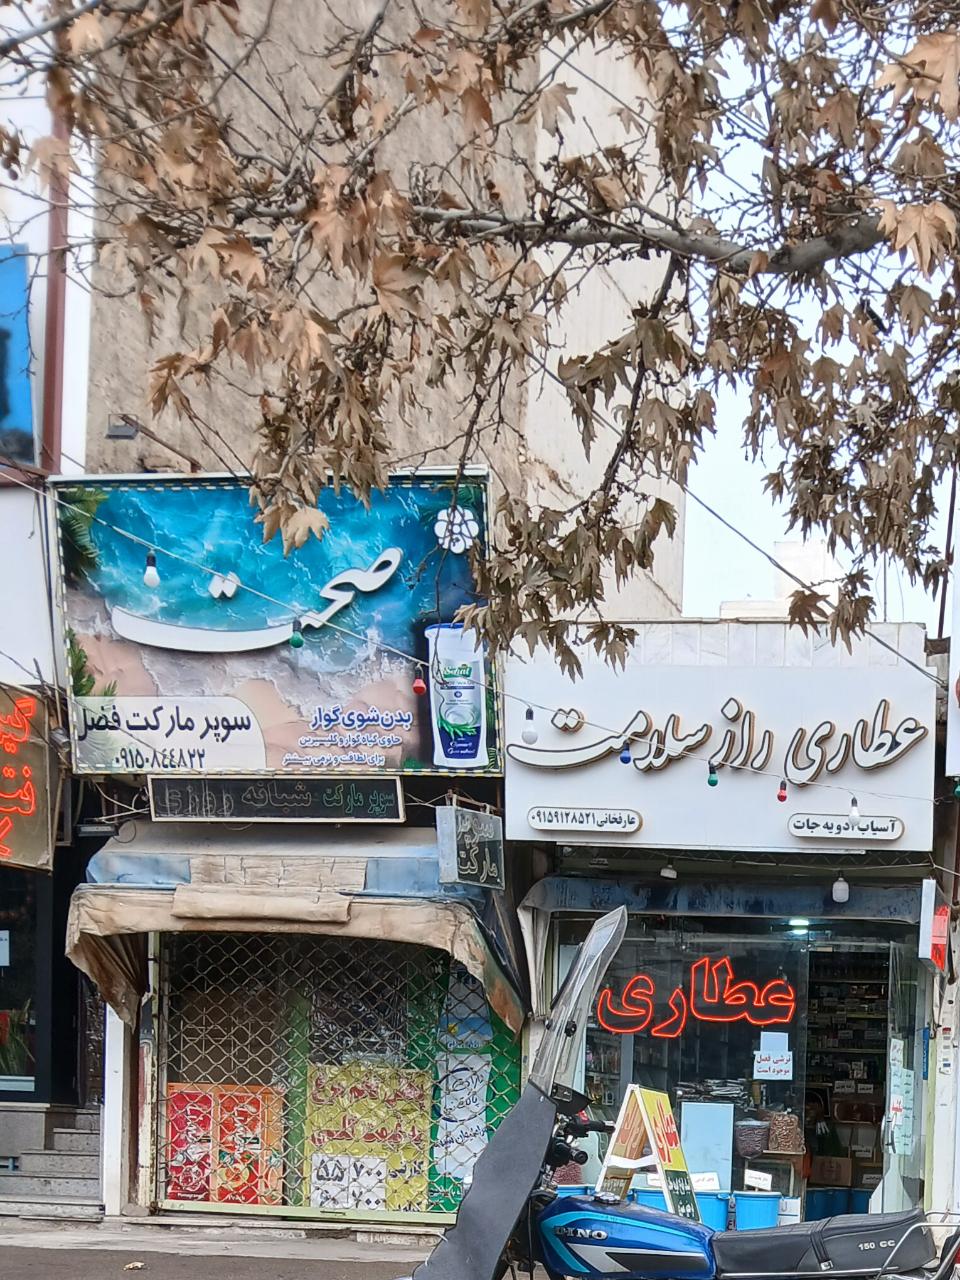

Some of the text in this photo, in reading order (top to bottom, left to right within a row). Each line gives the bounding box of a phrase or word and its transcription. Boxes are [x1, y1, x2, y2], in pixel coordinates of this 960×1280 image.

[78, 704, 252, 743] سوپر مارکت فضل
[310, 705, 341, 729] گوار
[506, 697, 928, 787] عطاری راز سلامت
[241, 780, 313, 814] شبانه
[322, 784, 364, 814] مارکت
[793, 818, 821, 834] جات
[856, 818, 898, 835] آسیاب
[597, 956, 796, 1039] عطاری
[555, 1226, 609, 1240] DINO
[858, 1239, 896, 1252] 150 CC
